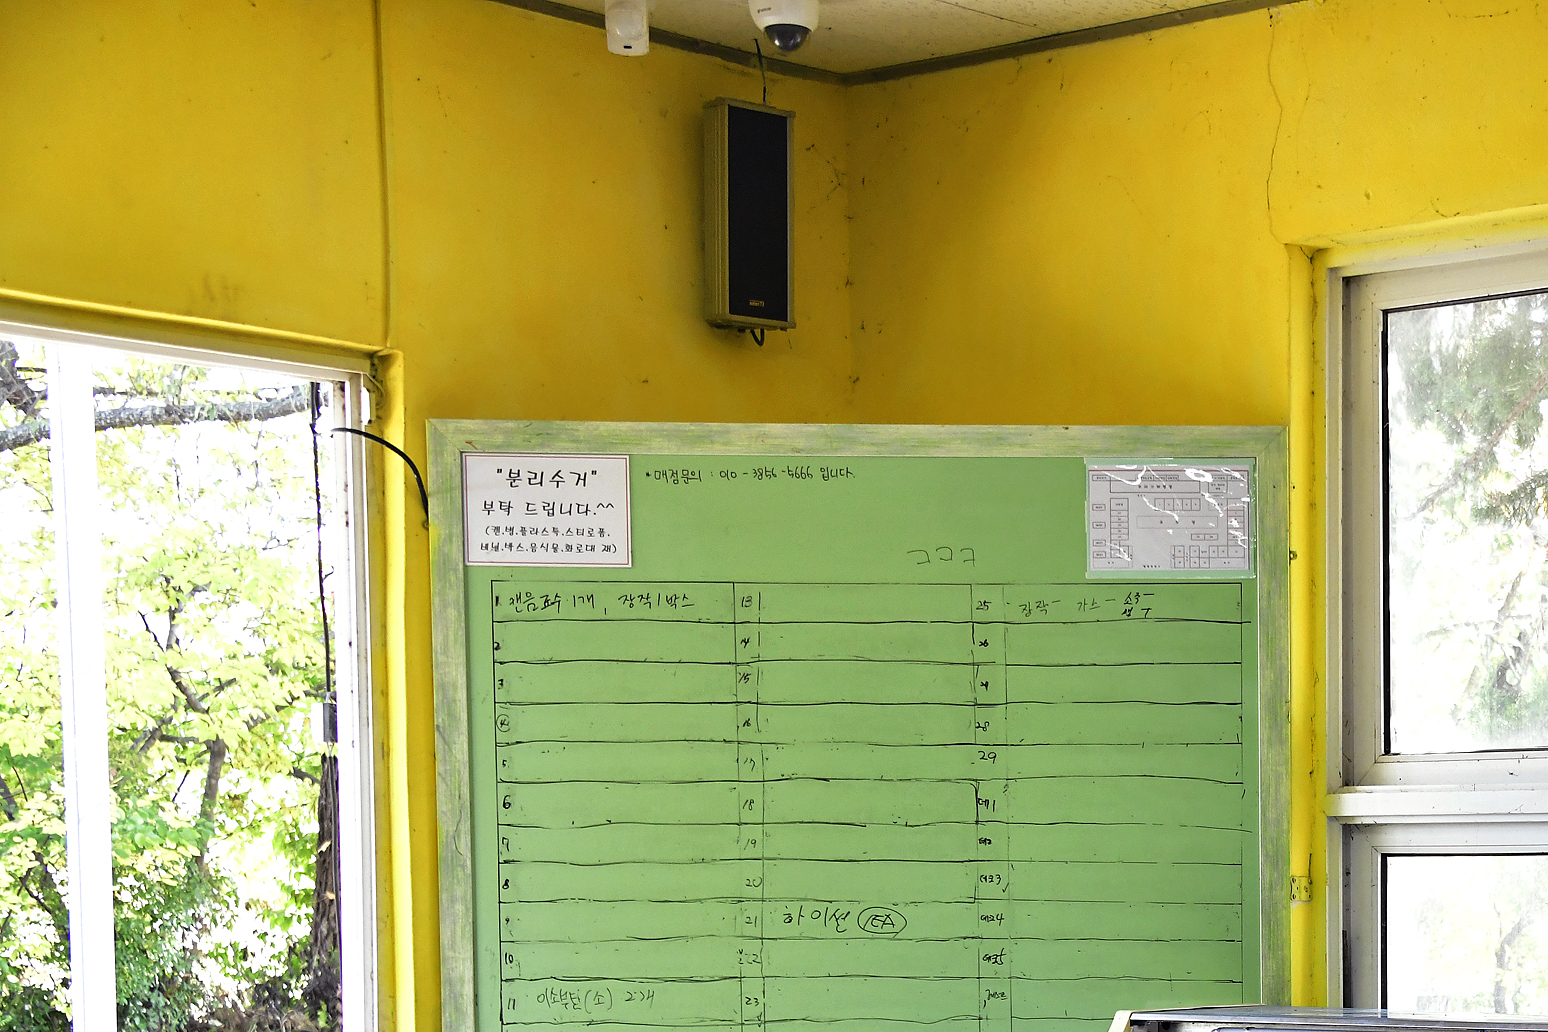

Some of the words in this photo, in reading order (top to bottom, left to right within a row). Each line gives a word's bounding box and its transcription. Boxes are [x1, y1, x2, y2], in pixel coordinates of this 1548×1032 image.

[481, 500, 514, 516] 부탁
[978, 750, 997, 765] 29
[502, 794, 512, 810] 6
